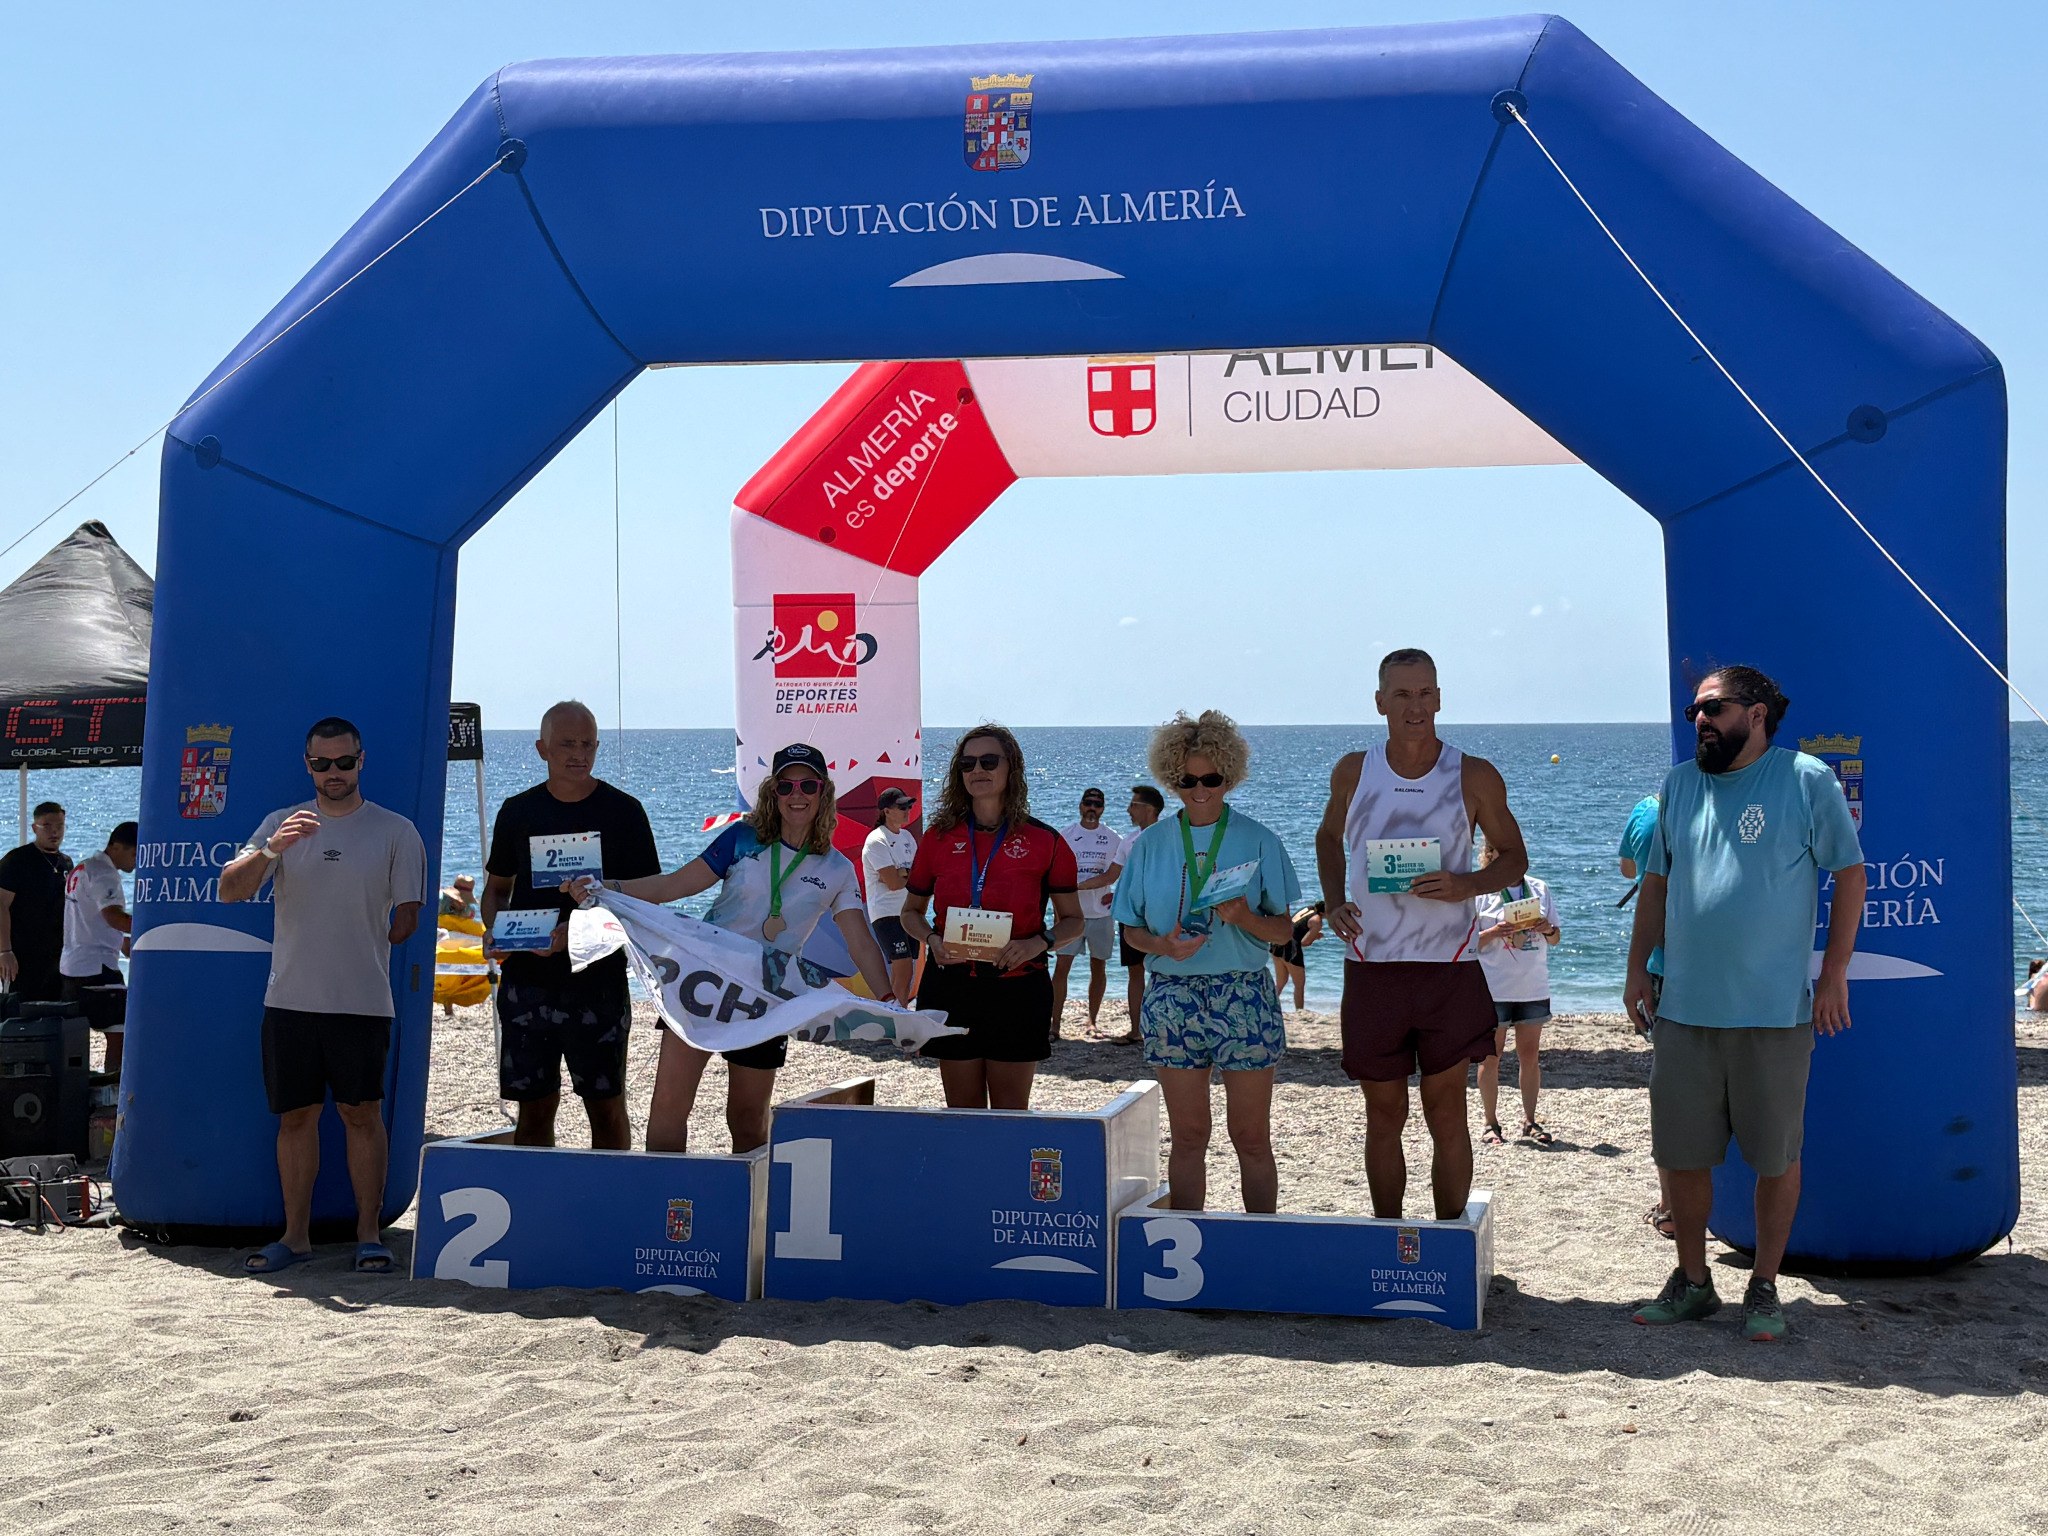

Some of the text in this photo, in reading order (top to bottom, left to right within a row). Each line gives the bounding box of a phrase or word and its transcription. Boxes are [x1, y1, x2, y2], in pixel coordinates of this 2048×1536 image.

[760, 179, 1246, 238] DIPUTACIÓN DE ALMERÍA
[1224, 386, 1381, 423] CIUDAD
[823, 389, 936, 509] ALMERÍA
[846, 412, 959, 529] es deporte
[776, 688, 858, 701] DEPORTES
[776, 702, 858, 714] DE ALMERIA
[136, 878, 154, 903] DE
[773, 1137, 843, 1261] 1
[991, 1209, 1100, 1230] DIPUTACIÓN
[433, 1187, 511, 1289] 2
[993, 1228, 1098, 1248] DE ALMERÍA
[635, 1247, 721, 1265] DIPUTACIÓN
[1142, 1217, 1204, 1302] 3
[635, 1261, 718, 1279] DE ALMERÍA
[1371, 1267, 1448, 1283] DIPUTACIÓN
[1372, 1281, 1446, 1295] DE ALMERÍA
